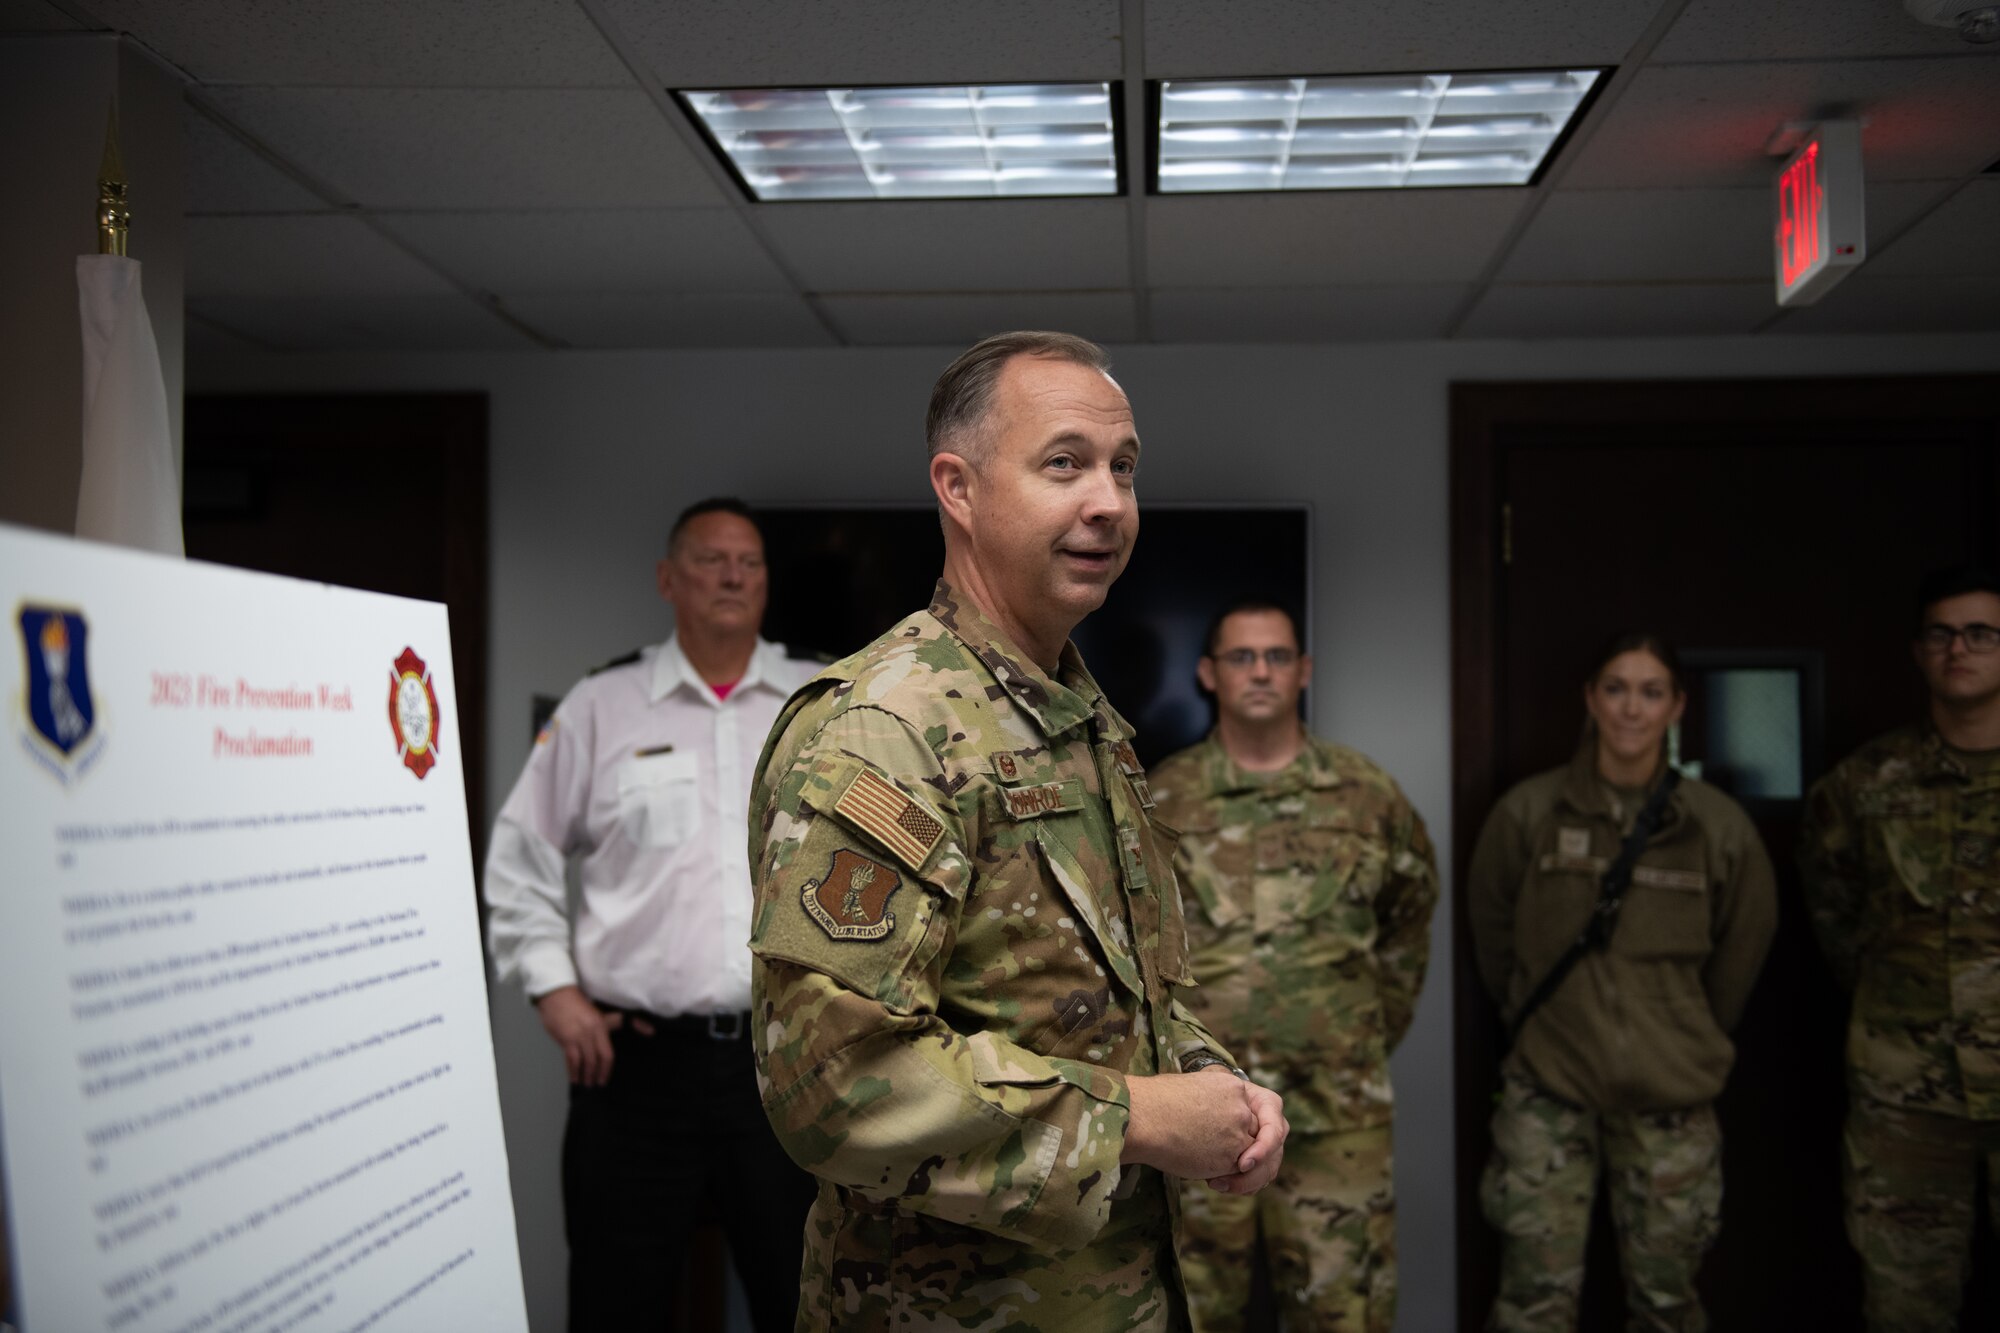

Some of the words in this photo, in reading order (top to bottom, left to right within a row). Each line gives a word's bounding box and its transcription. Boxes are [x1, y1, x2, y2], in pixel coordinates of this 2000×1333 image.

[1780, 141, 1818, 285] EXIT
[197, 673, 230, 709] Fire
[236, 677, 314, 712] Prevention
[318, 683, 353, 712] Week
[213, 724, 313, 760] Proclamation
[1007, 786, 1065, 814] ONROE
[836, 923, 885, 937] LIBERTATIS
